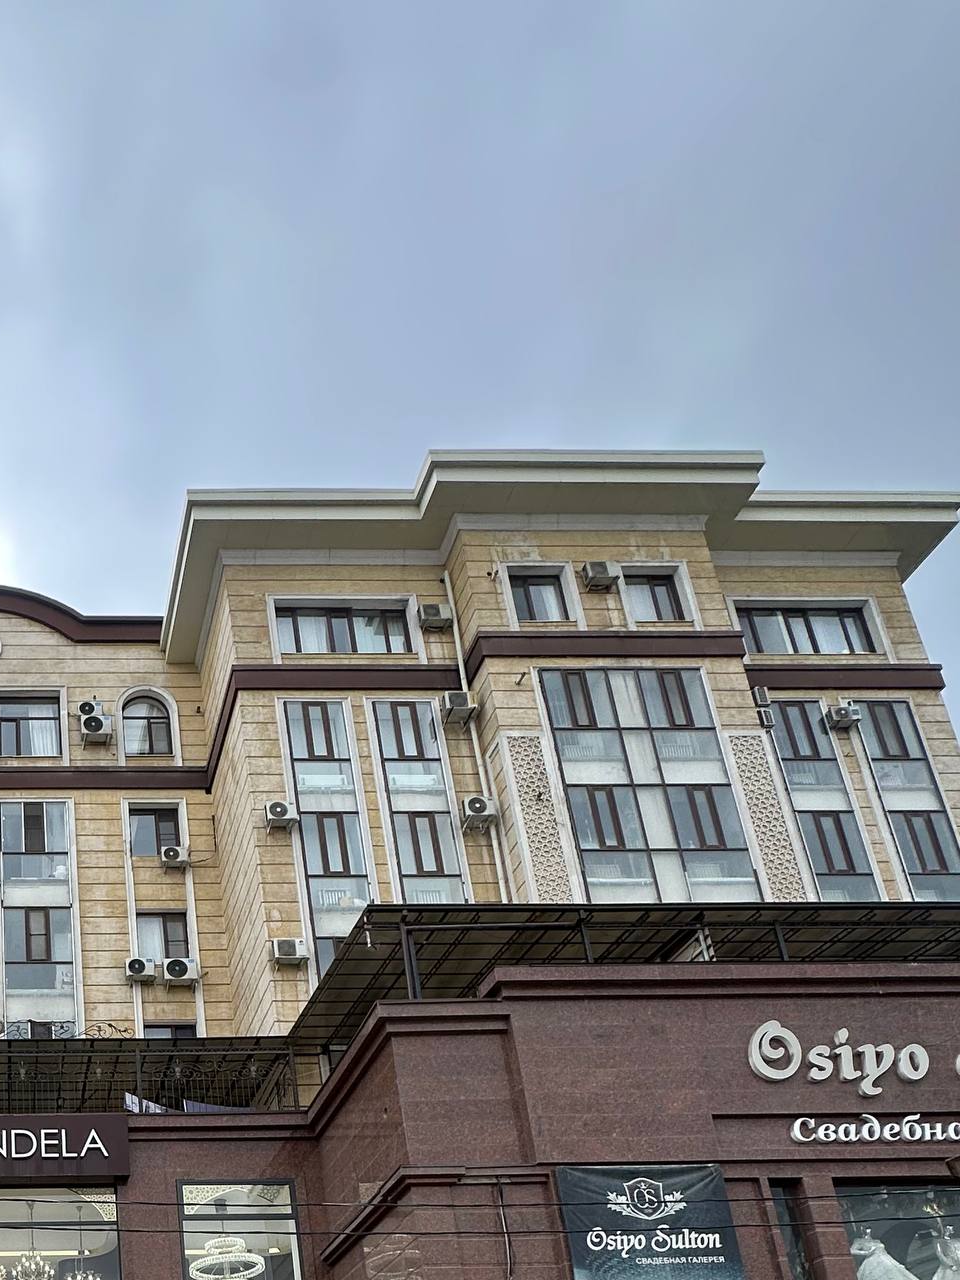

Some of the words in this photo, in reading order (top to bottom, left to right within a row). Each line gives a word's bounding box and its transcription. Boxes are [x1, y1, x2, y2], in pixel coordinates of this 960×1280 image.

[748, 1020, 929, 1097] Osiyo
[586, 1226, 646, 1258] Osiyo
[651, 1224, 723, 1252] Sulton
[635, 1256, 686, 1265] СВАДЕБНАЯ
[688, 1255, 725, 1264] ГАЛЕРЕЯ
